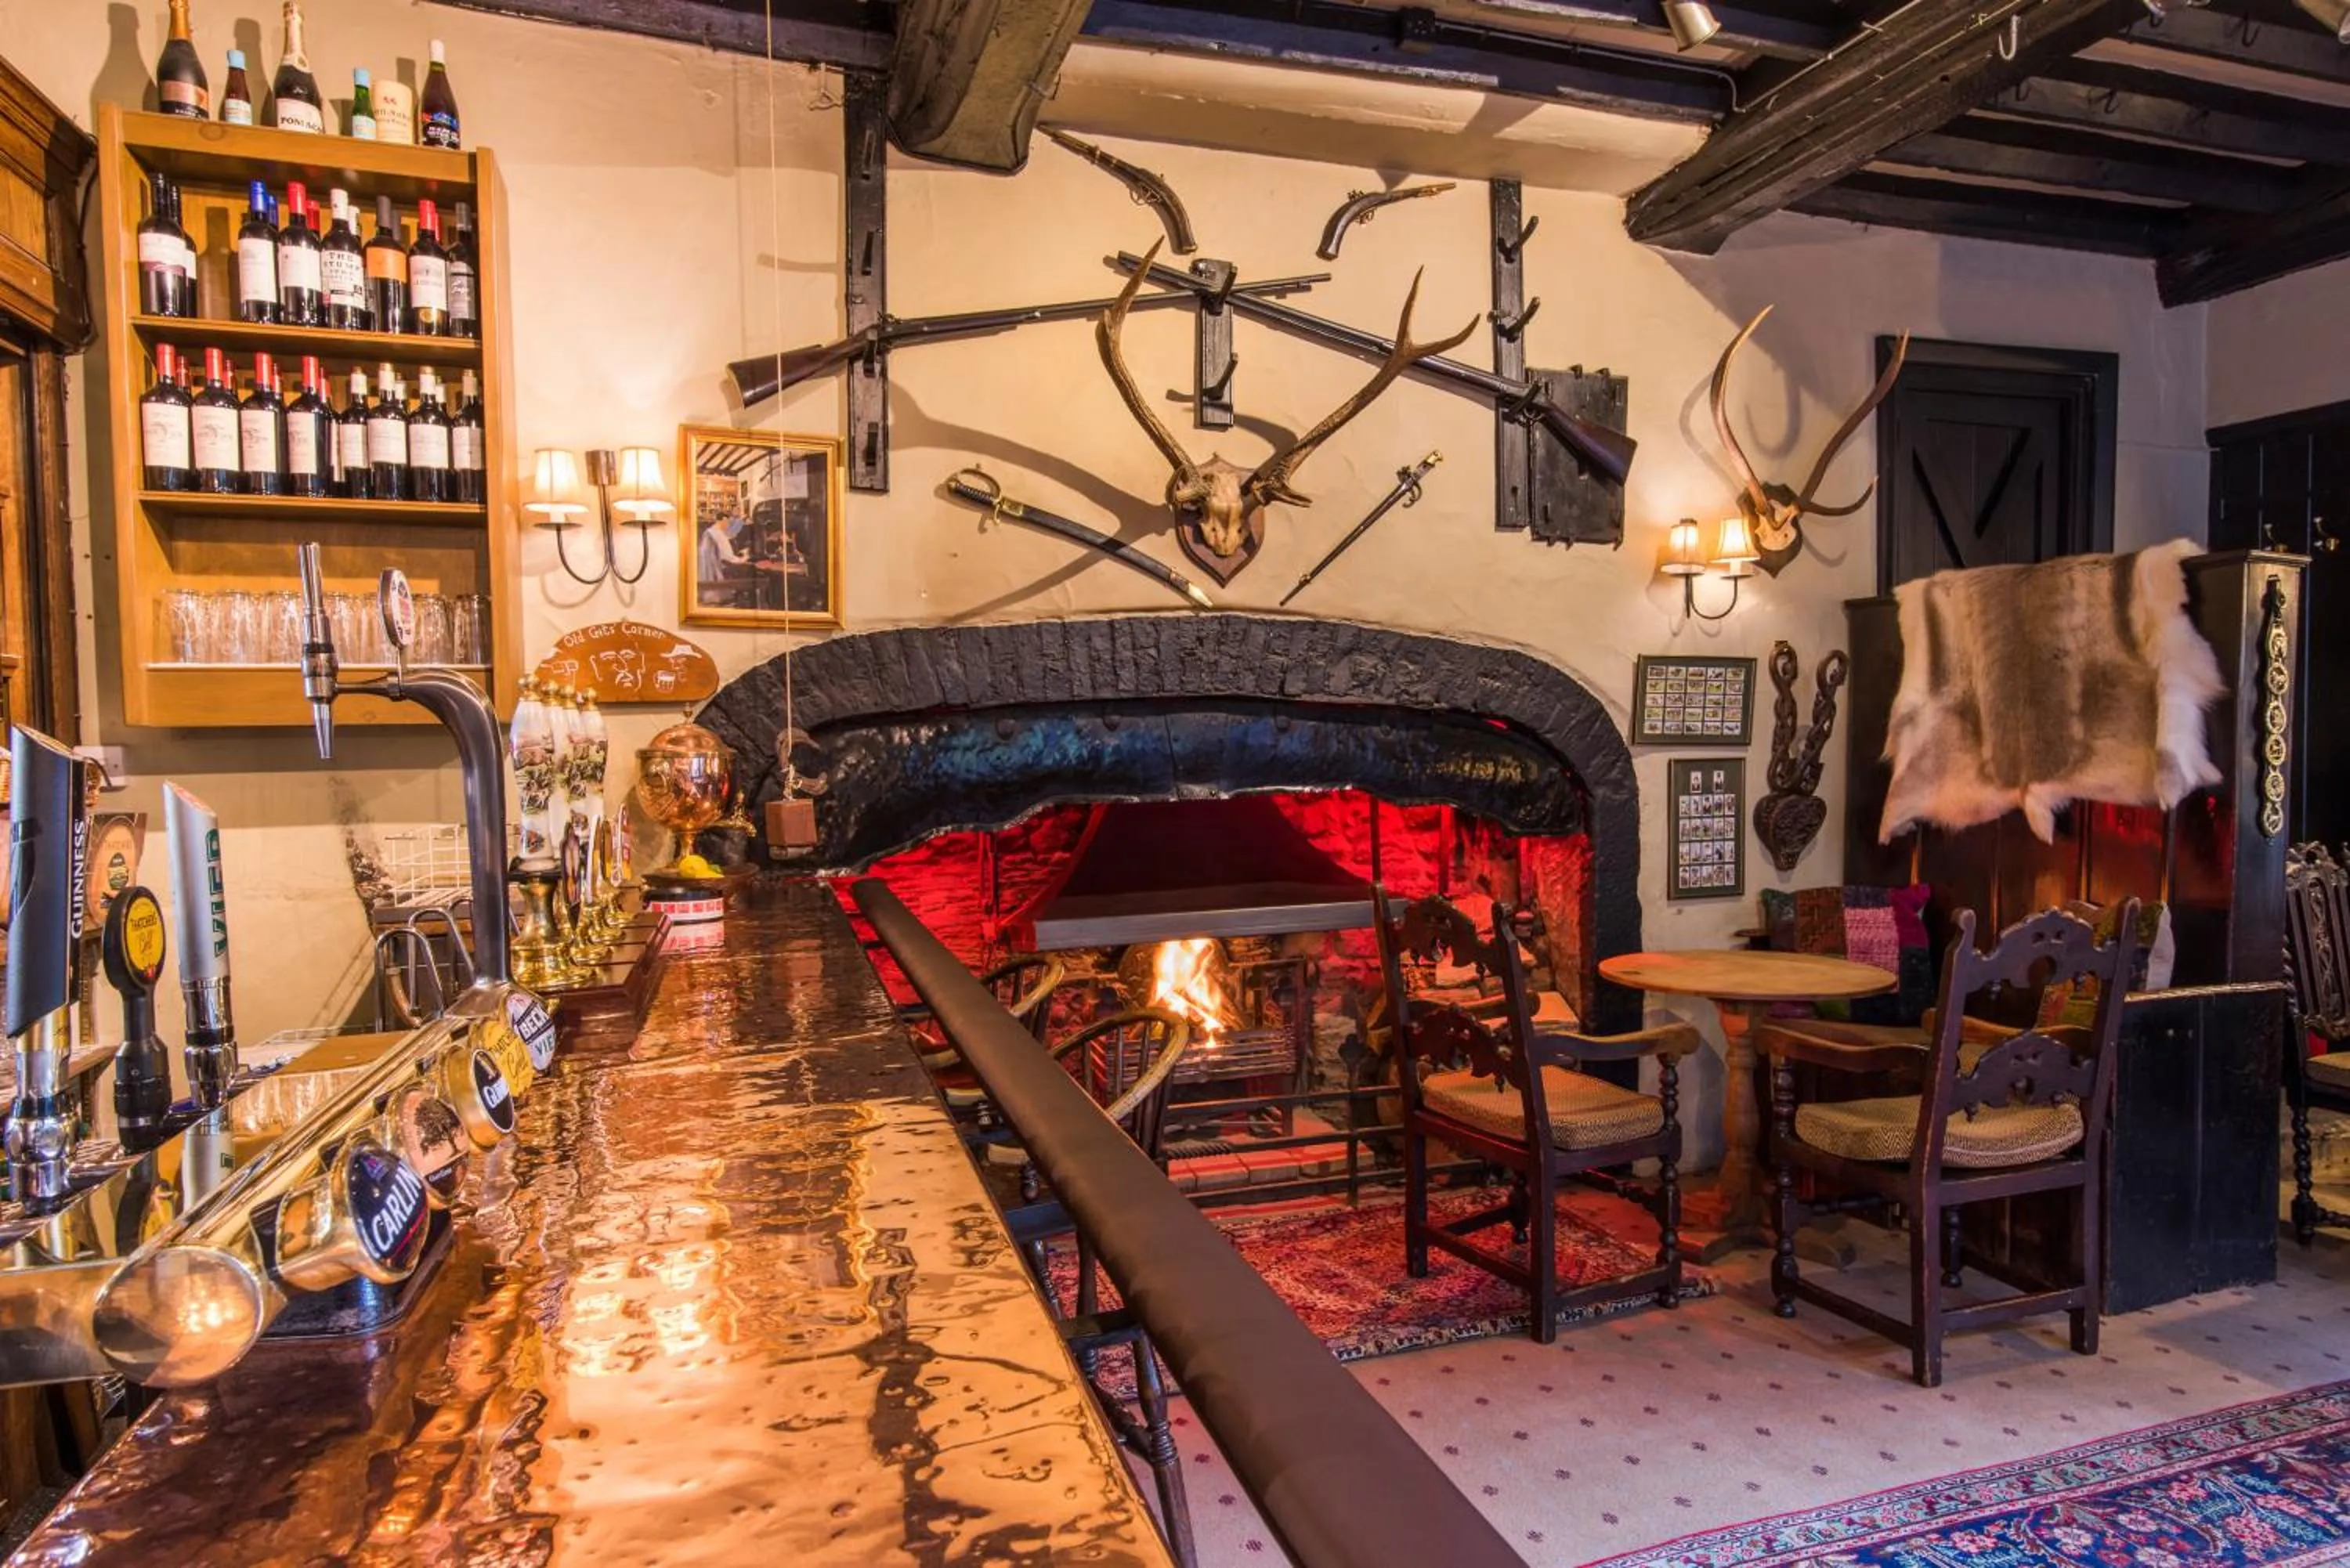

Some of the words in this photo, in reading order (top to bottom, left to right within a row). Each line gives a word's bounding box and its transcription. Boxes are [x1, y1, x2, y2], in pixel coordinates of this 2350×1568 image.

[563, 630, 585, 648] Old
[621, 623, 667, 640] Corner
[71, 820, 85, 939] GUINNESS
